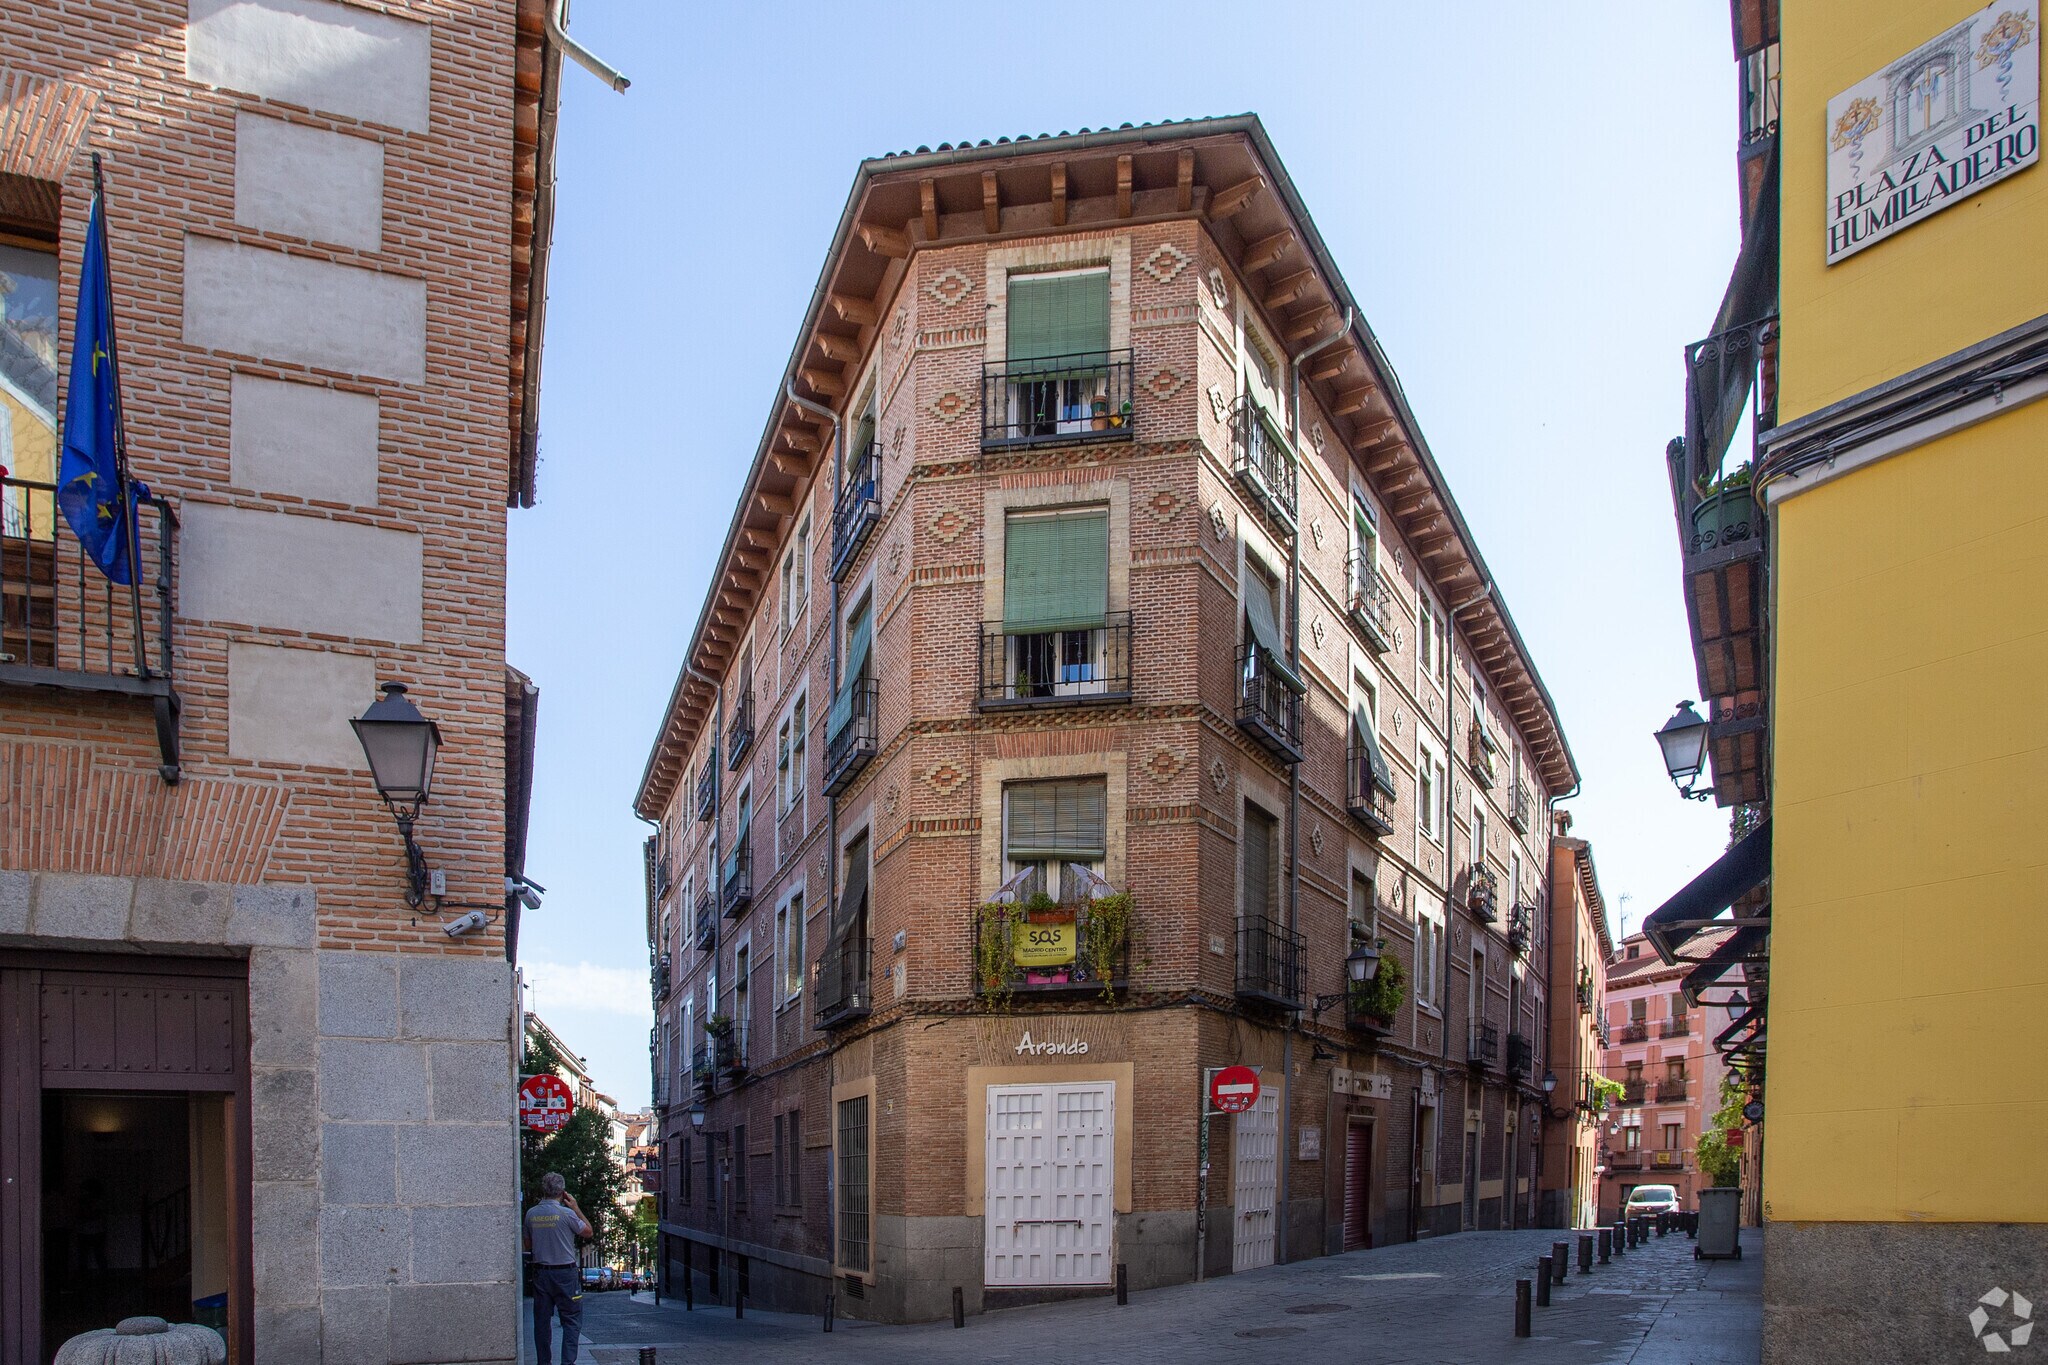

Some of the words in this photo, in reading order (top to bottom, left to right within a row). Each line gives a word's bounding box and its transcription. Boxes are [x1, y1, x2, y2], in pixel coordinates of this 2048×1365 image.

[1828, 124, 2037, 257] HUMILADERO
[1834, 144, 1949, 221] PLAZA
[1963, 103, 2029, 150] DEL
[1015, 1030, 1089, 1056] Aranda
